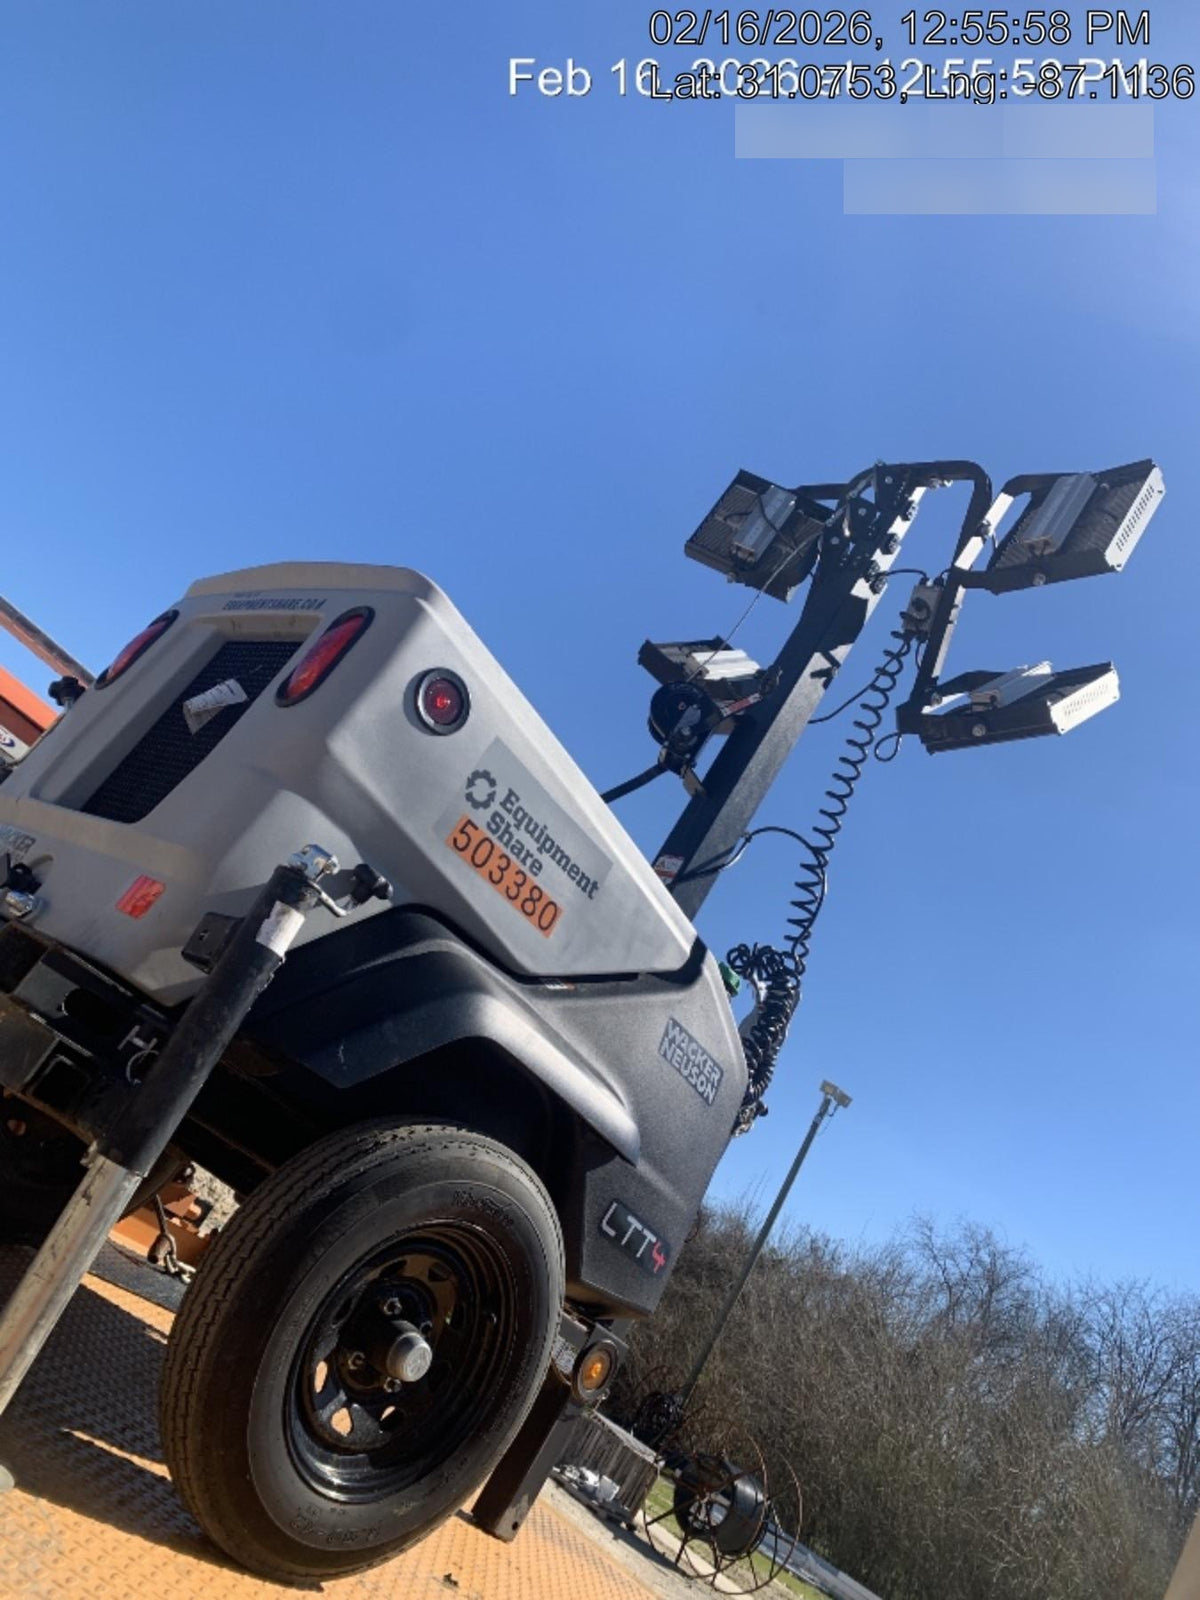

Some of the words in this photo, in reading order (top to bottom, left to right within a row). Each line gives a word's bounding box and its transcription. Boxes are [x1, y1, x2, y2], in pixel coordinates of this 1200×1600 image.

[452, 818, 559, 933] 503380
[485, 810, 544, 878] Share
[499, 787, 601, 900] Equipment
[660, 1036, 716, 1105] NEUSON
[667, 1019, 721, 1087] WACKER
